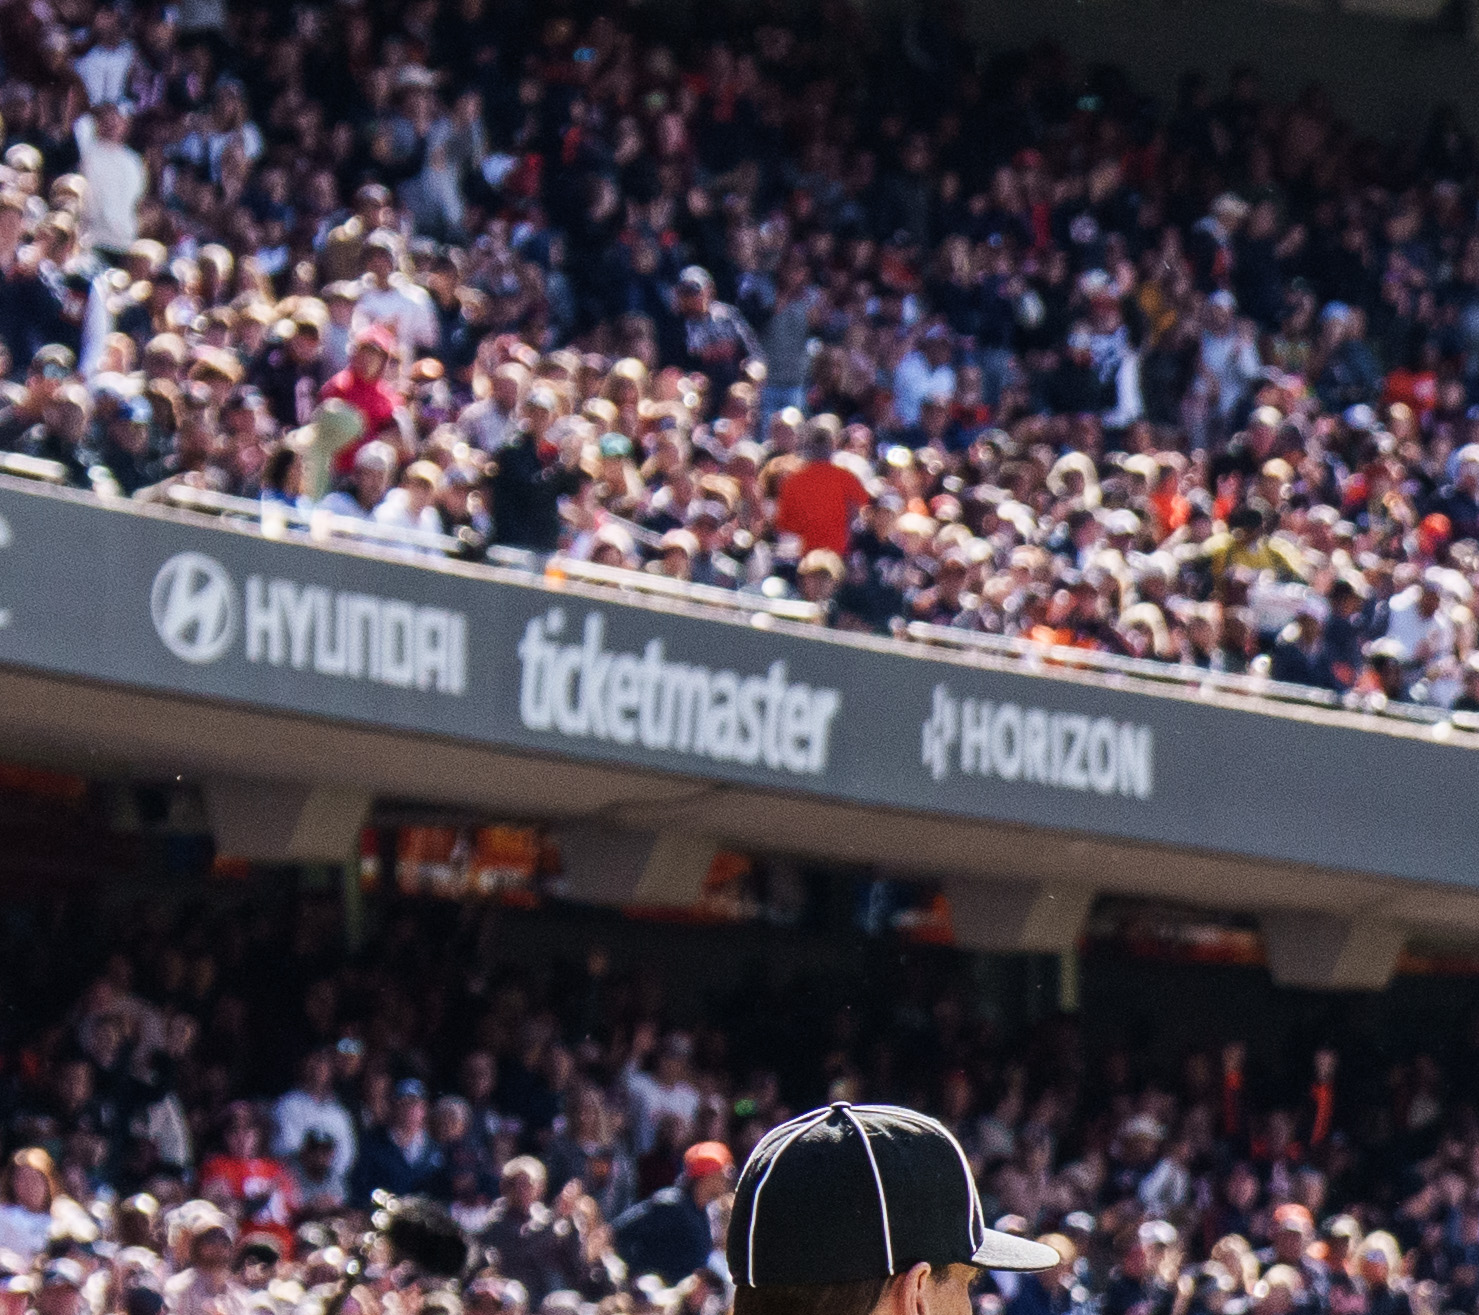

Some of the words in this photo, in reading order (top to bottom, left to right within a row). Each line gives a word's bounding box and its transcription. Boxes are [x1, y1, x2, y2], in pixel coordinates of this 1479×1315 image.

[245, 574, 469, 696] HYUNDAI
[519, 606, 840, 776] ticketmaster
[961, 697, 1154, 800] HORIZON
